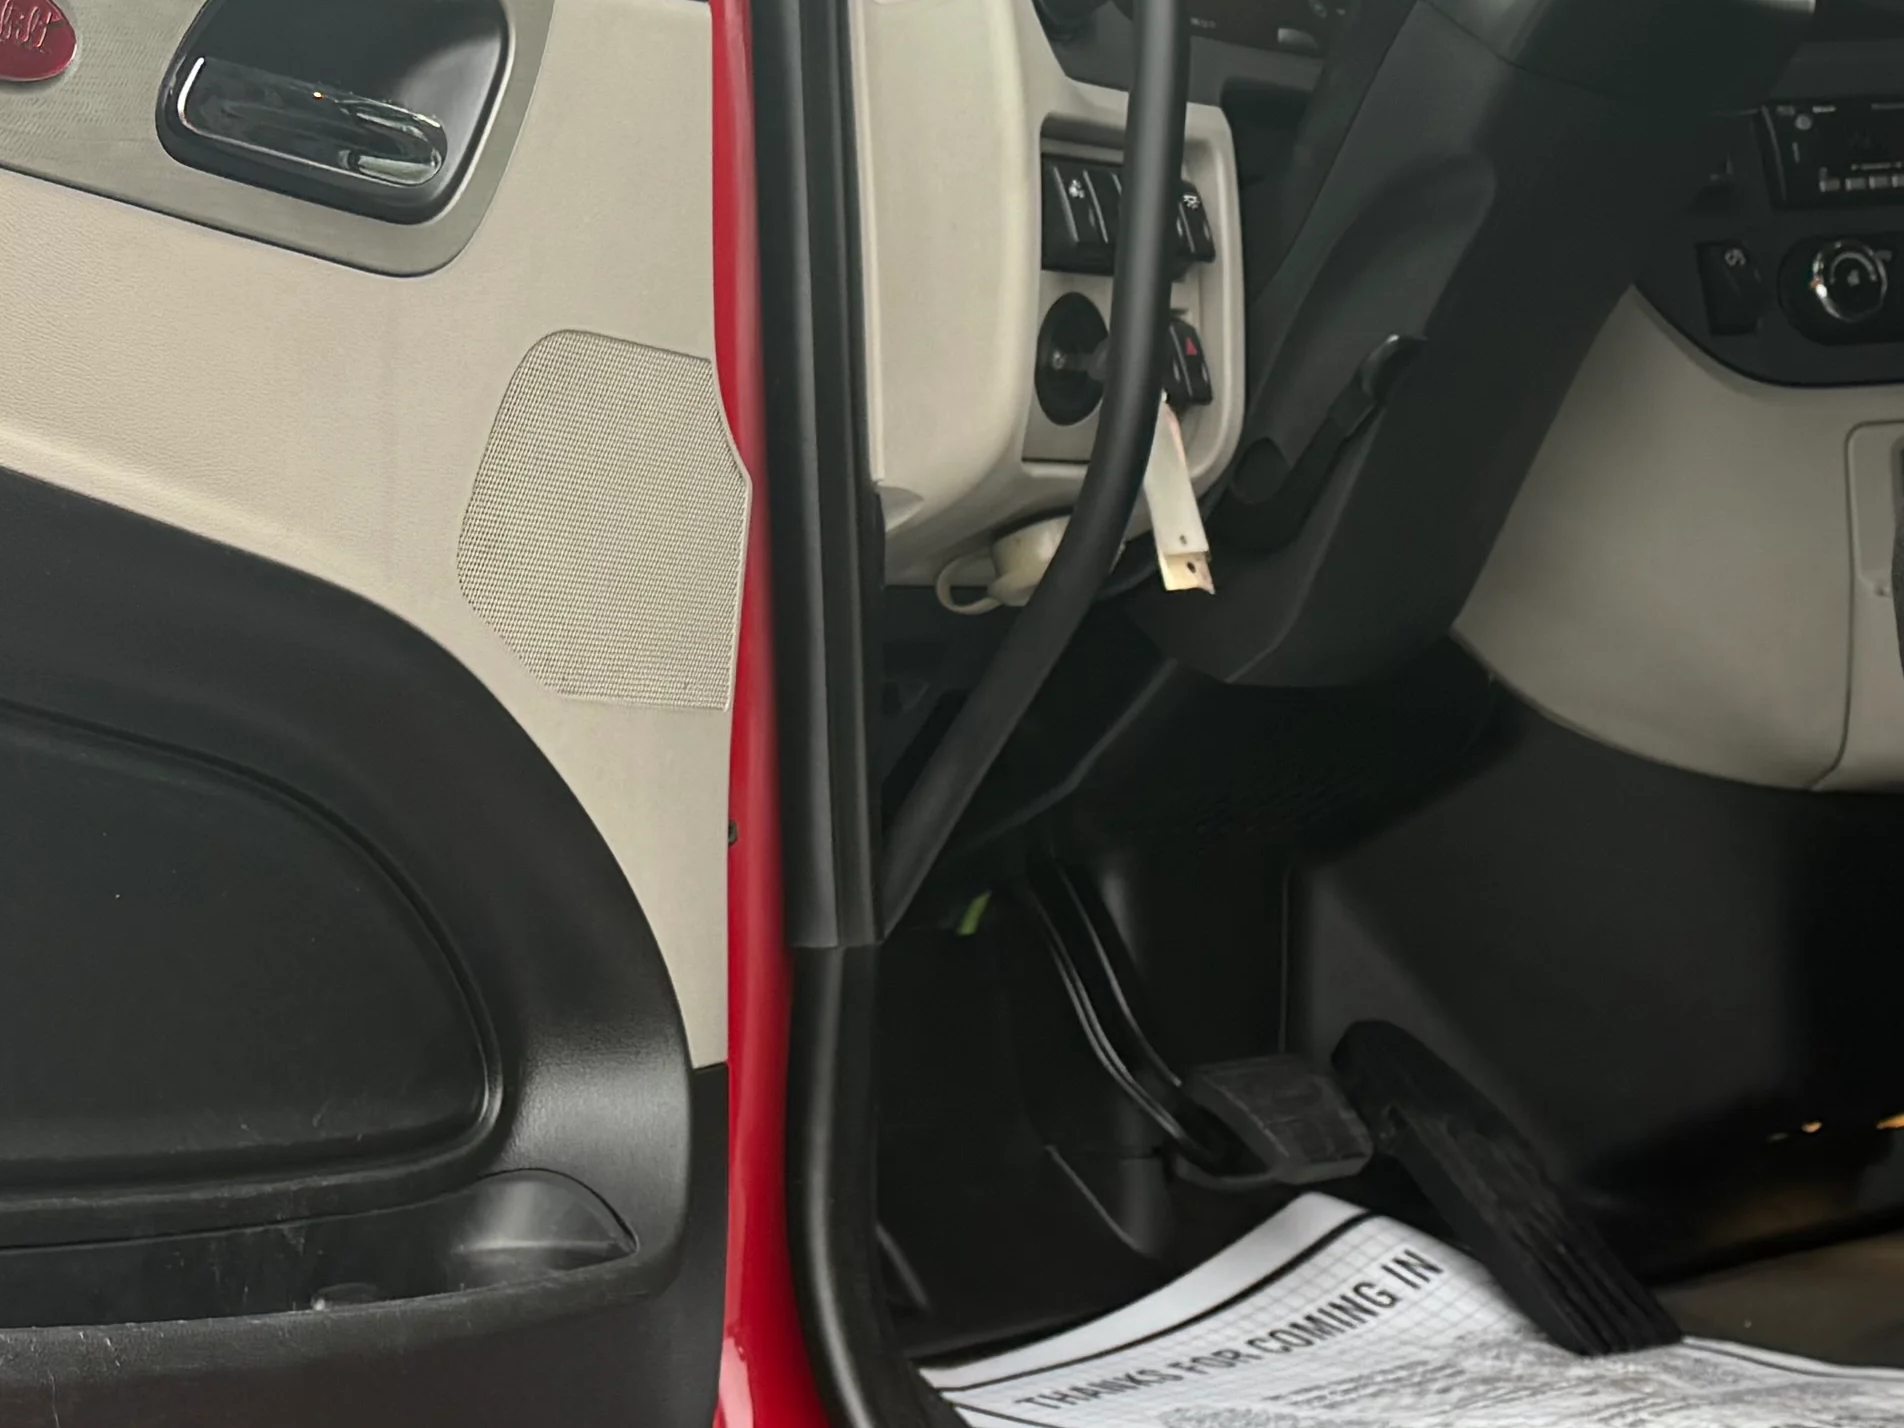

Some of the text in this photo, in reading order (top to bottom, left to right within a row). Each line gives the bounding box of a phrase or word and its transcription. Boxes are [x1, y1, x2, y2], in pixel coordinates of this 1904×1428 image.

[1013, 1247, 1445, 1410] THANKS FOR COMING IN
